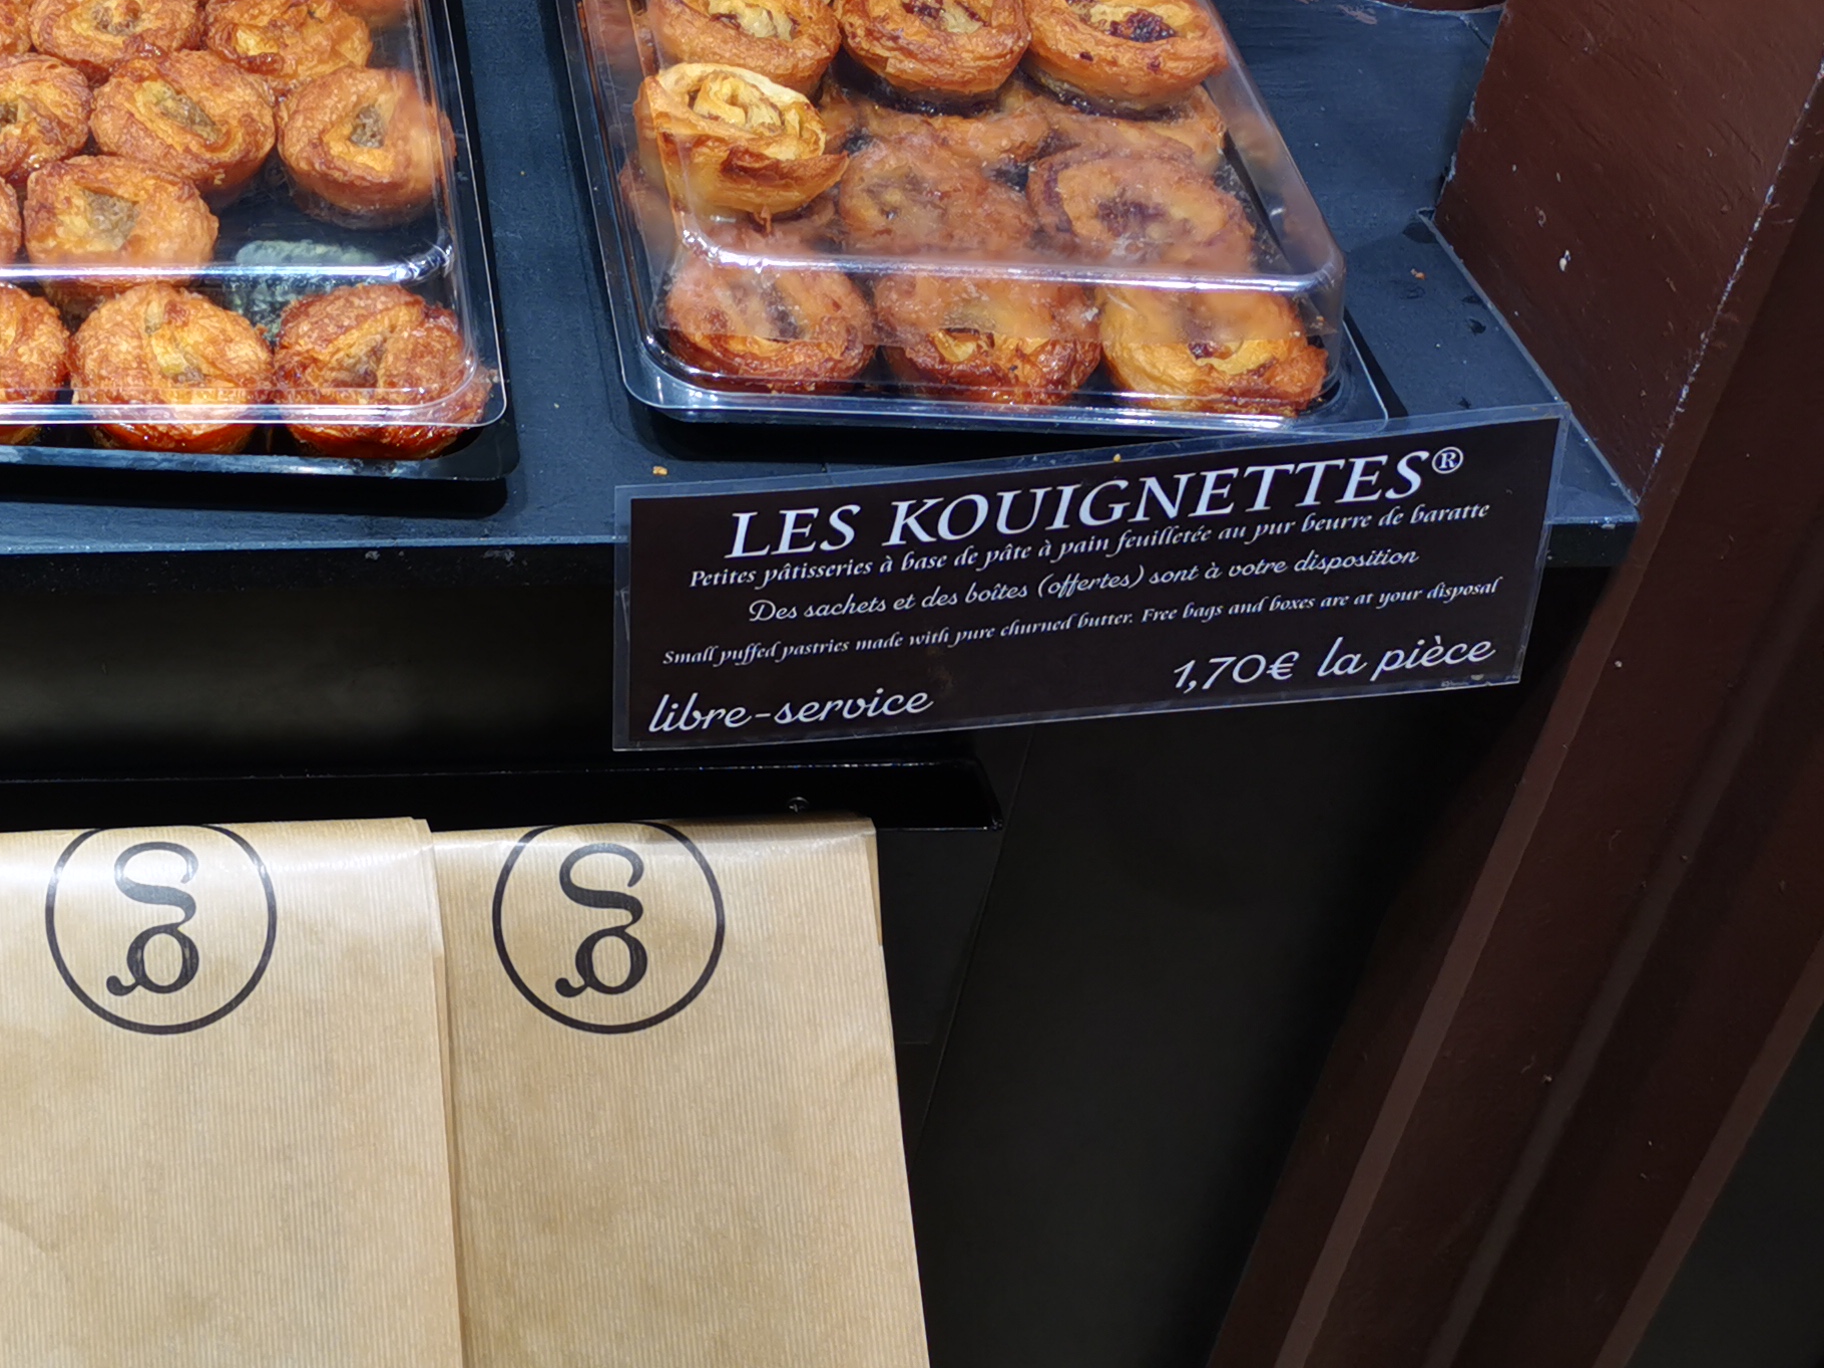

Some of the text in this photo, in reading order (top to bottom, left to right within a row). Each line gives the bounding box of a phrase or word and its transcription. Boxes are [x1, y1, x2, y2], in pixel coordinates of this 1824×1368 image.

[689, 501, 1490, 590] Petites pâtisseries à base de pâte à pain feuilletée au pur beurre de baratte
[724, 504, 861, 559] LES
[748, 547, 1419, 622] Des sachets et des boîtes (offertes) sont à votre disposition
[662, 576, 1503, 668] Small puffed pastries made with pure churned butter. Free bags and boxes are at your disposal
[1173, 634, 1496, 694] 1,70€ la pièce
[648, 688, 934, 734] libre-service
